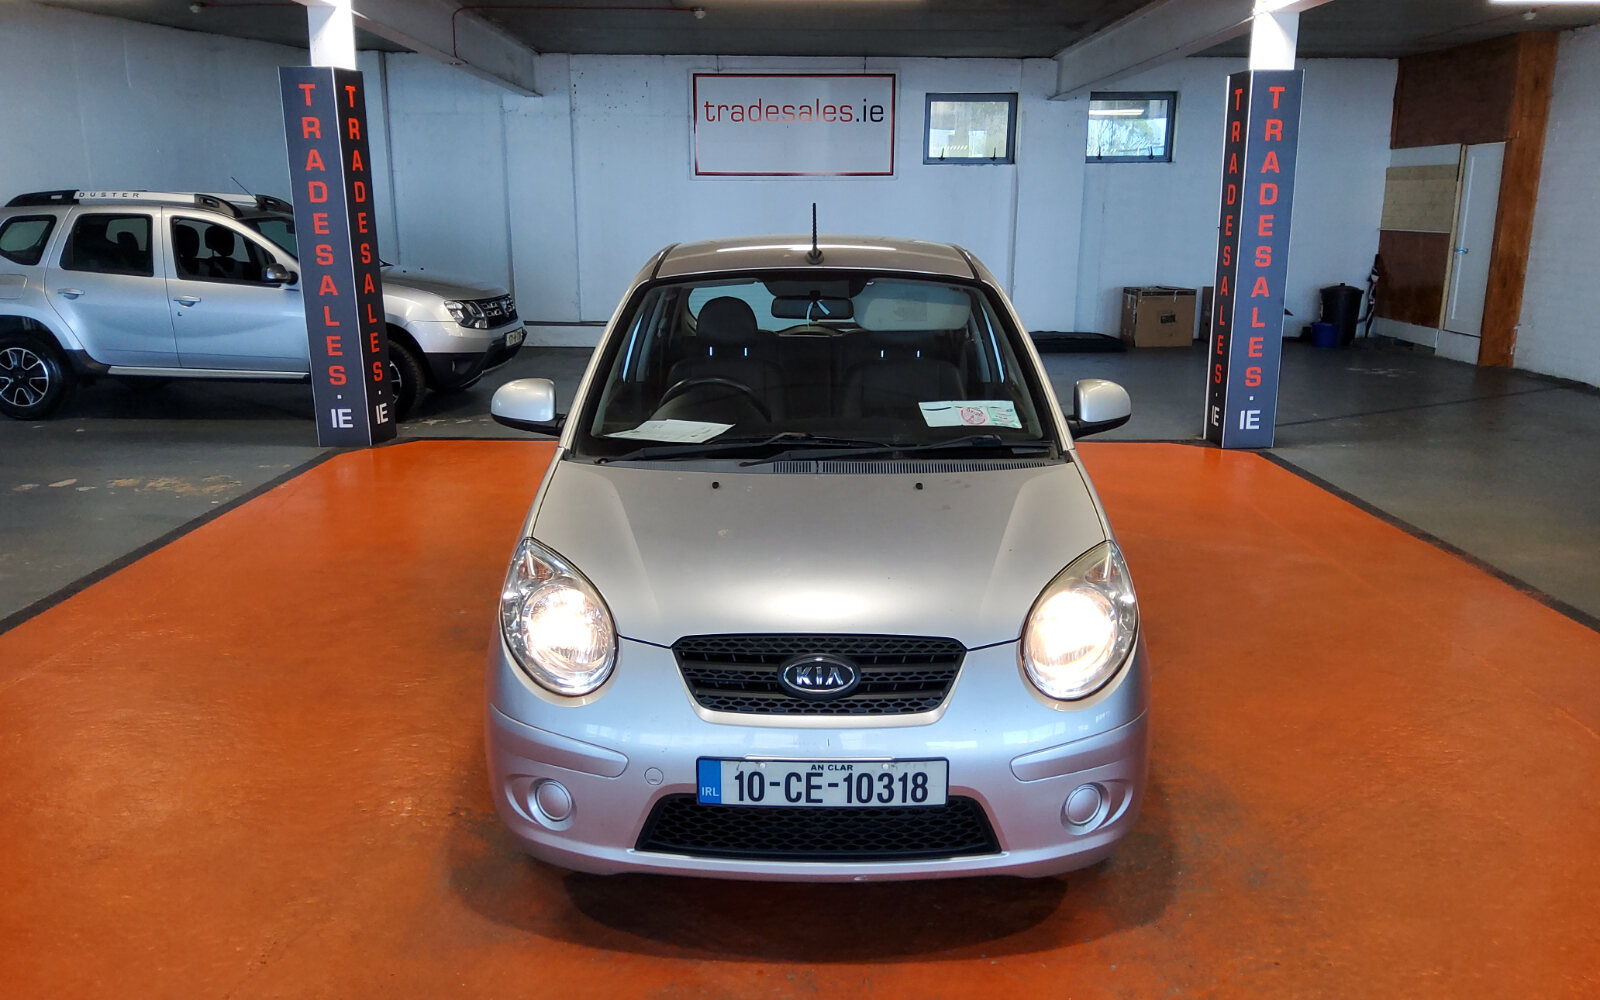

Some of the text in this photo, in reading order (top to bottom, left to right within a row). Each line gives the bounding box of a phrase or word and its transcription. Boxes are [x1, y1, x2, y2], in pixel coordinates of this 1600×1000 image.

[704, 98, 884, 122] tradesales.ie
[796, 666, 844, 685] KIA
[701, 786, 720, 797] IRL
[734, 771, 929, 804] 10-CE-10318
